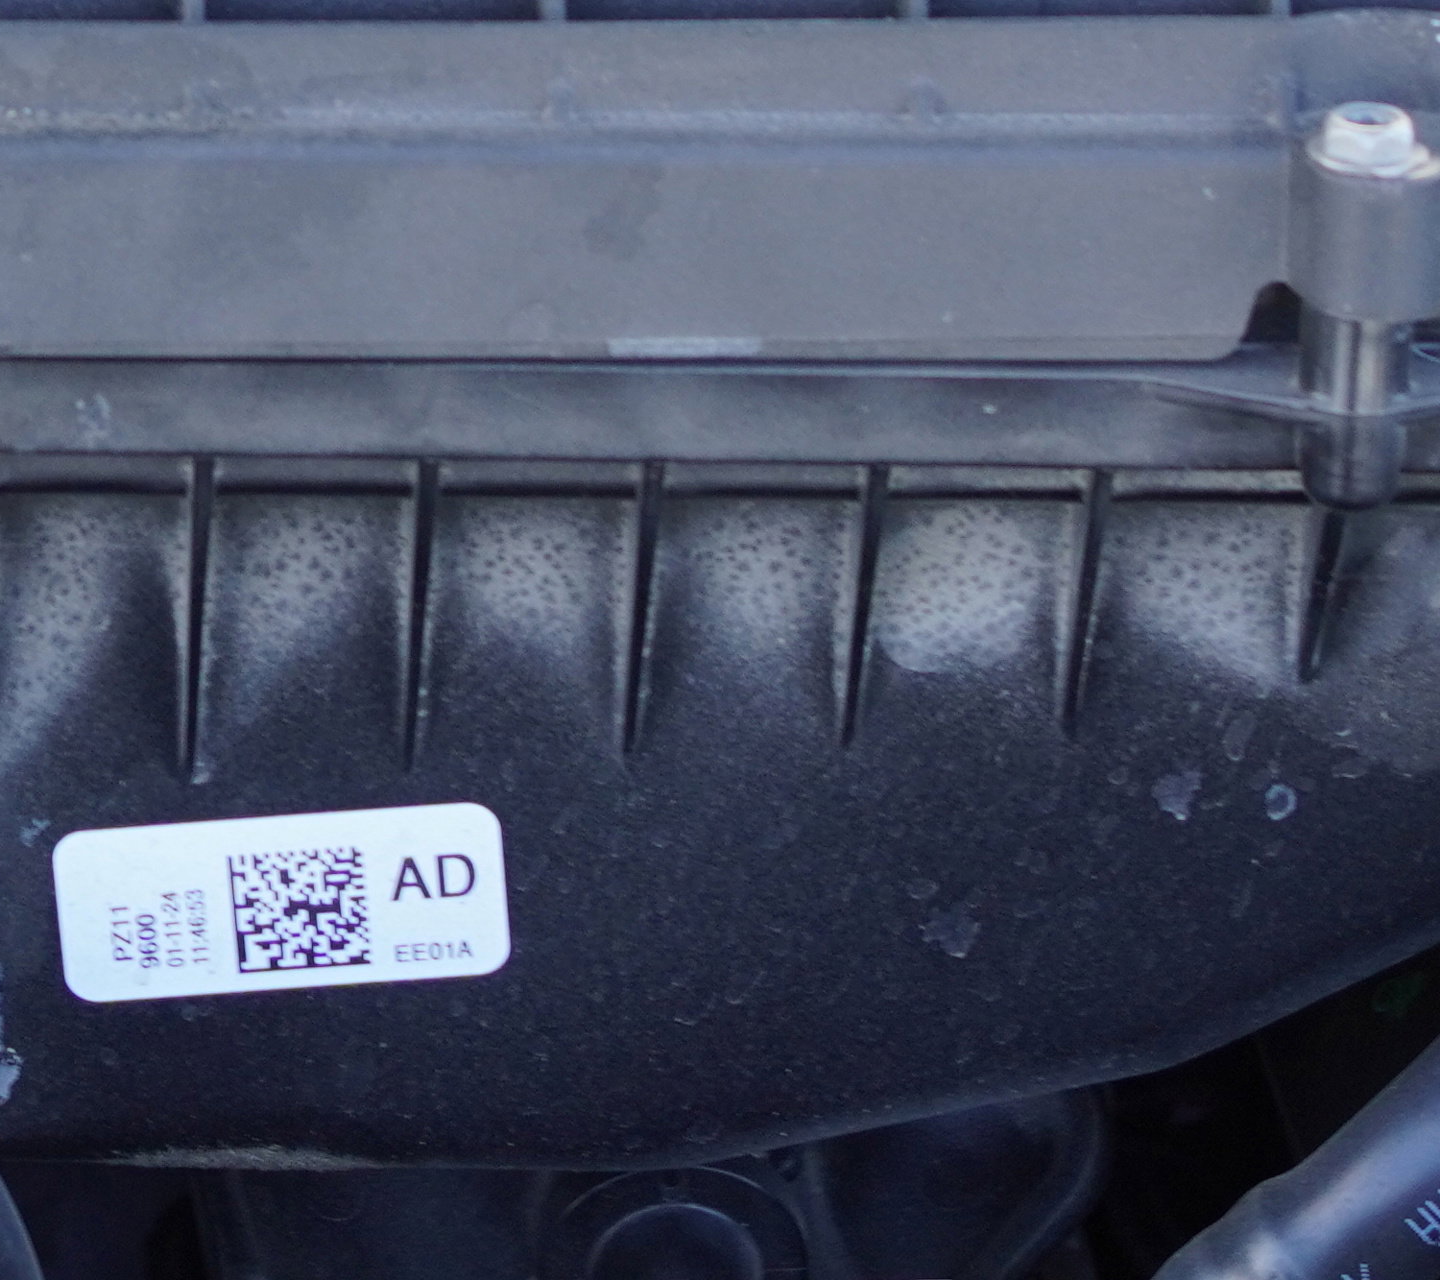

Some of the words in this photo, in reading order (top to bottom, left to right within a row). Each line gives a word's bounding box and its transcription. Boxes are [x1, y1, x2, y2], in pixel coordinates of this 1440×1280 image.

[391, 853, 475, 901] AD
[110, 907, 133, 961] PZ11
[135, 914, 160, 969] 9600
[395, 941, 474, 962] EE01A
